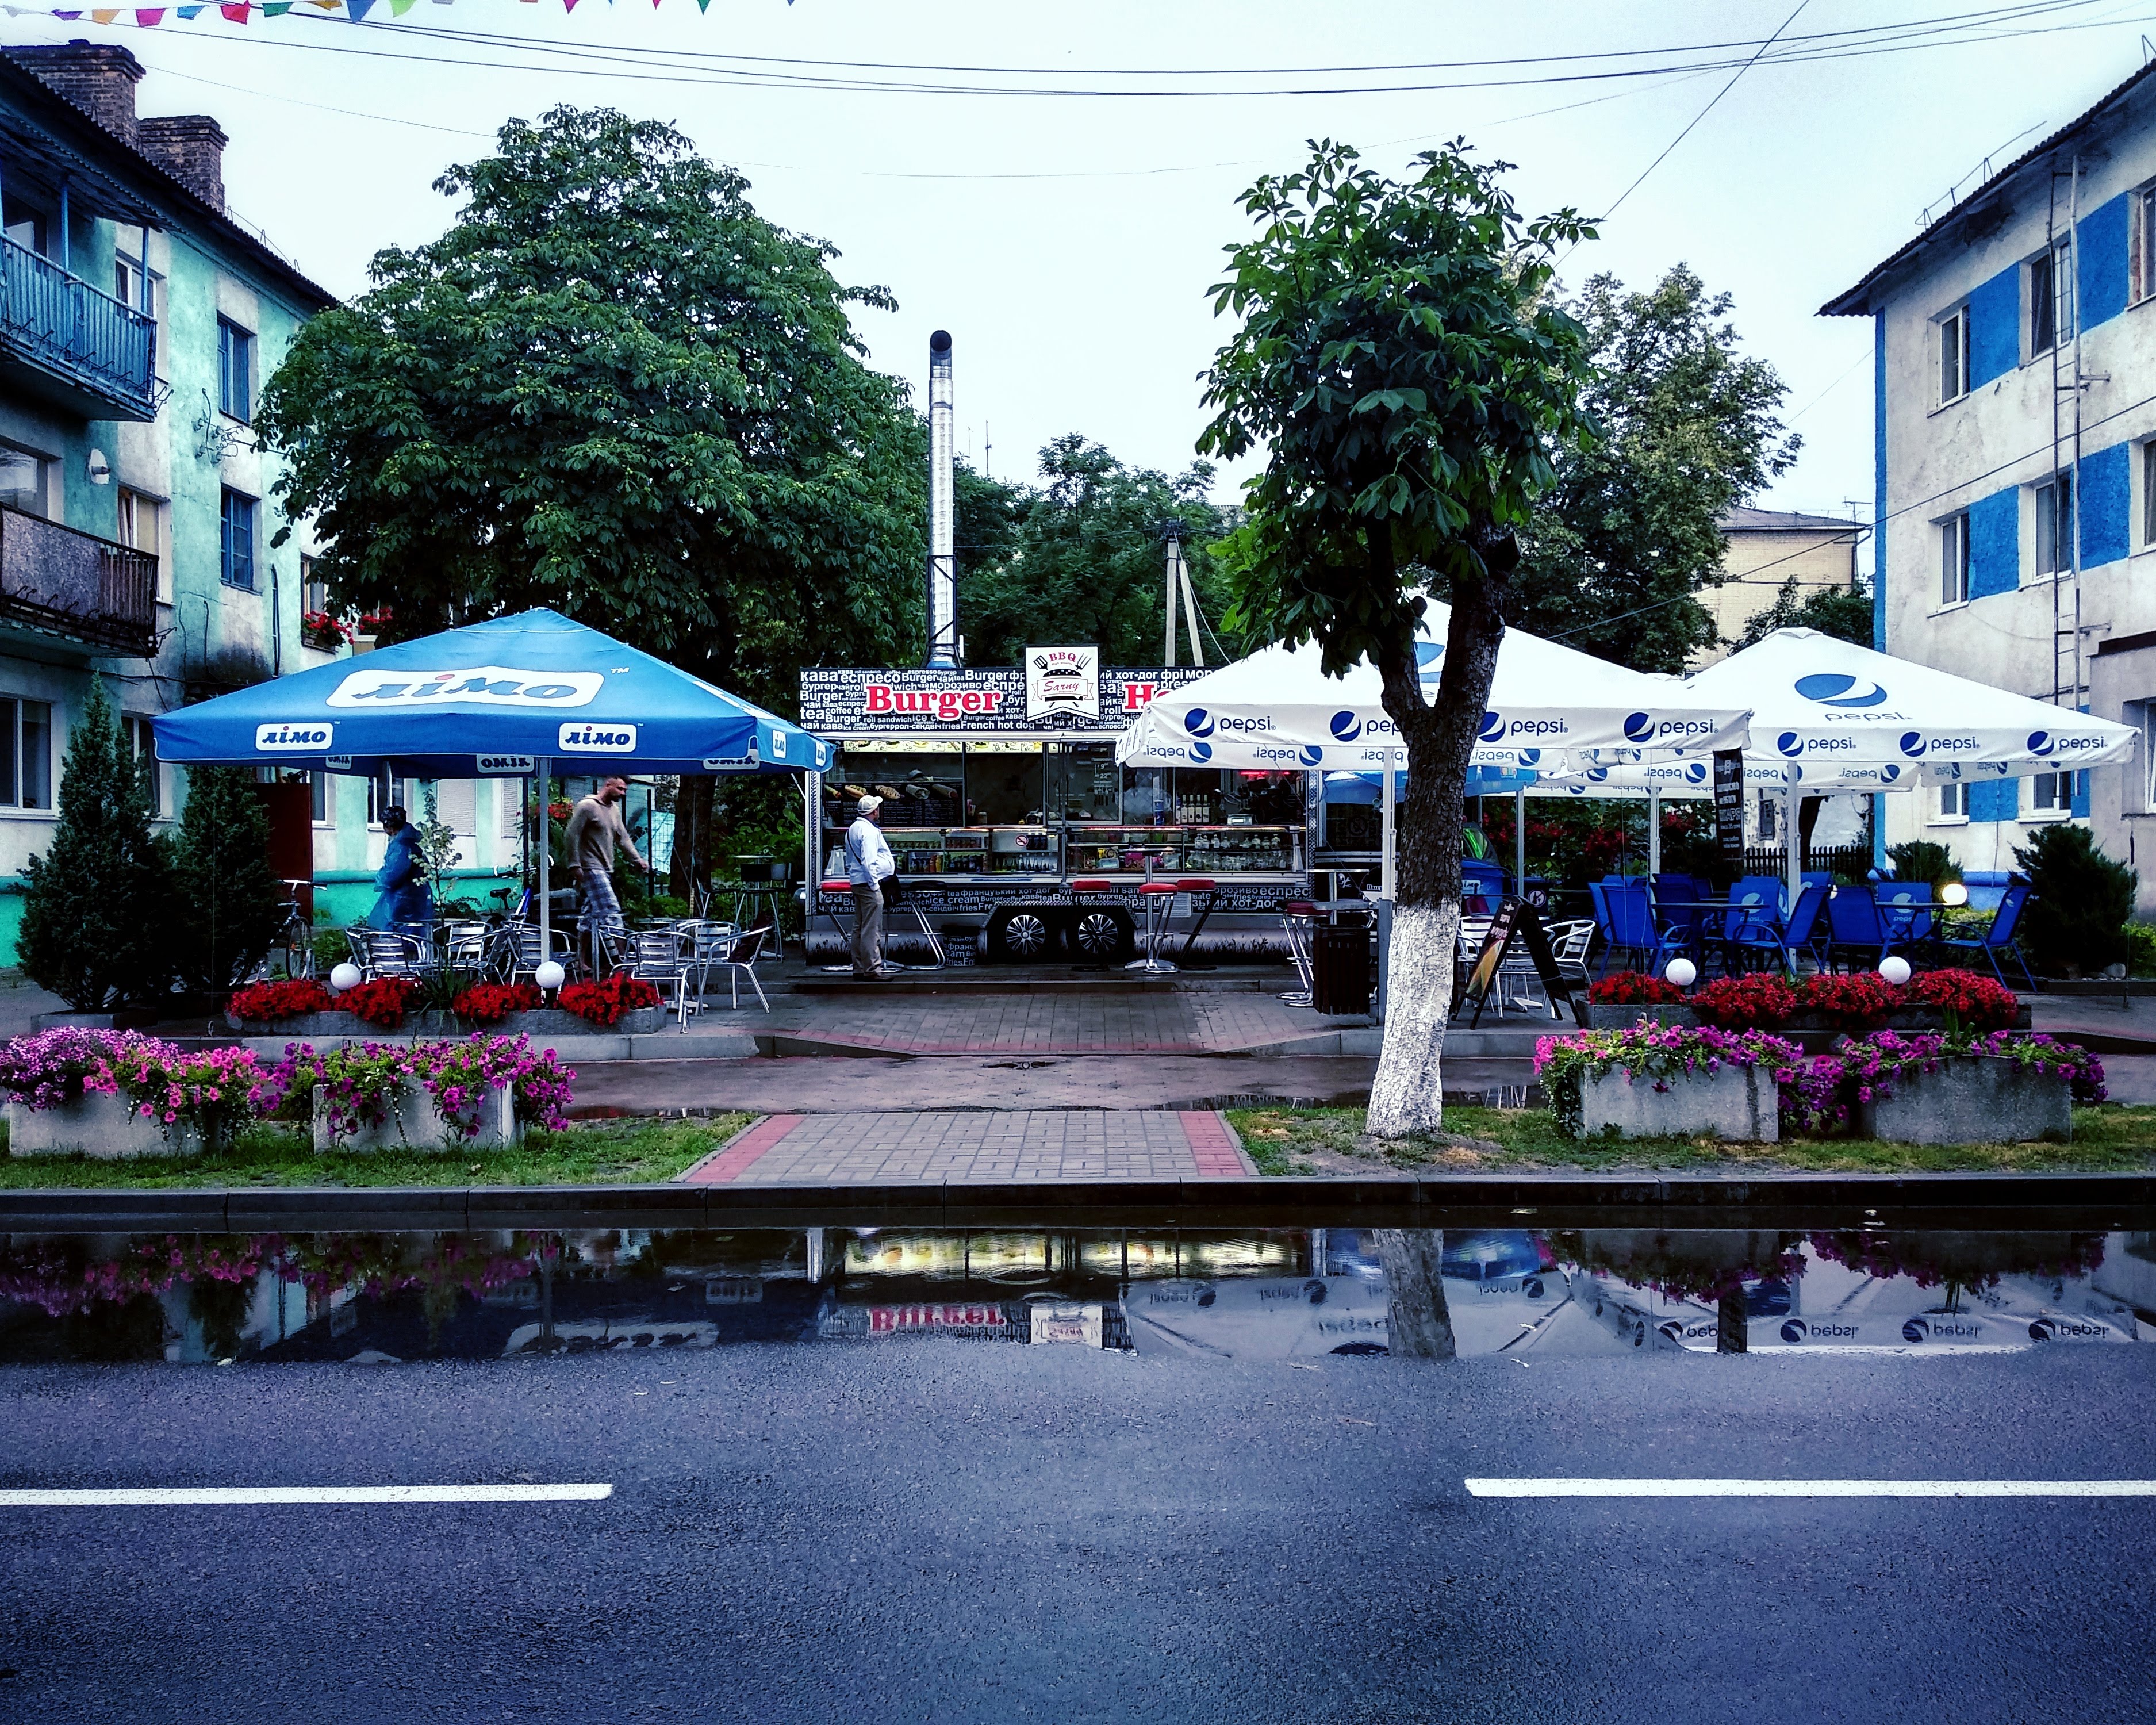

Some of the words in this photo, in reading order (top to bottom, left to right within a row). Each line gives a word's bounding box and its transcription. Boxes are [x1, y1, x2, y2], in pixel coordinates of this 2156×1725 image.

[1049, 652, 1076, 662] BBQ
[800, 671, 838, 682] кава
[840, 674, 901, 685] еспресо
[901, 672, 937, 683] Burger
[965, 670, 1008, 683] Burger
[1115, 672, 1158, 680] хот-дог
[1161, 669, 1183, 682] фрі
[802, 682, 837, 692] бургер
[850, 683, 863, 691] rol
[889, 683, 917, 691] dwich
[930, 682, 982, 691] морозиво
[983, 681, 1025, 693] еспре
[1044, 681, 1080, 692] Sarny
[1100, 683, 1116, 693] ea
[800, 690, 843, 702] Burger
[1100, 696, 1112, 706] ай
[866, 686, 1001, 719] Burger
[800, 707, 824, 719] tea
[1104, 706, 1121, 714] roll
[826, 714, 861, 724] Burger
[1825, 712, 1905, 722] pepsi
[800, 720, 819, 729] чай
[961, 720, 994, 729] French
[998, 720, 1014, 729] hot
[1016, 720, 1035, 730] dog
[1220, 716, 1272, 733] pepsi
[1367, 720, 1400, 735] pep
[1511, 718, 1563, 736] pepsi
[1660, 719, 1713, 737] pepsi
[262, 726, 327, 743] лімо
[565, 726, 630, 745] лімо
[1808, 737, 1852, 752] pepsi
[1931, 736, 1976, 752] pepsi
[2059, 736, 2104, 750] pepsi
[1260, 888, 1308, 898] еспрес
[930, 896, 945, 904] ice
[1232, 900, 1277, 909] хот-дог
[819, 904, 837, 912] чй
